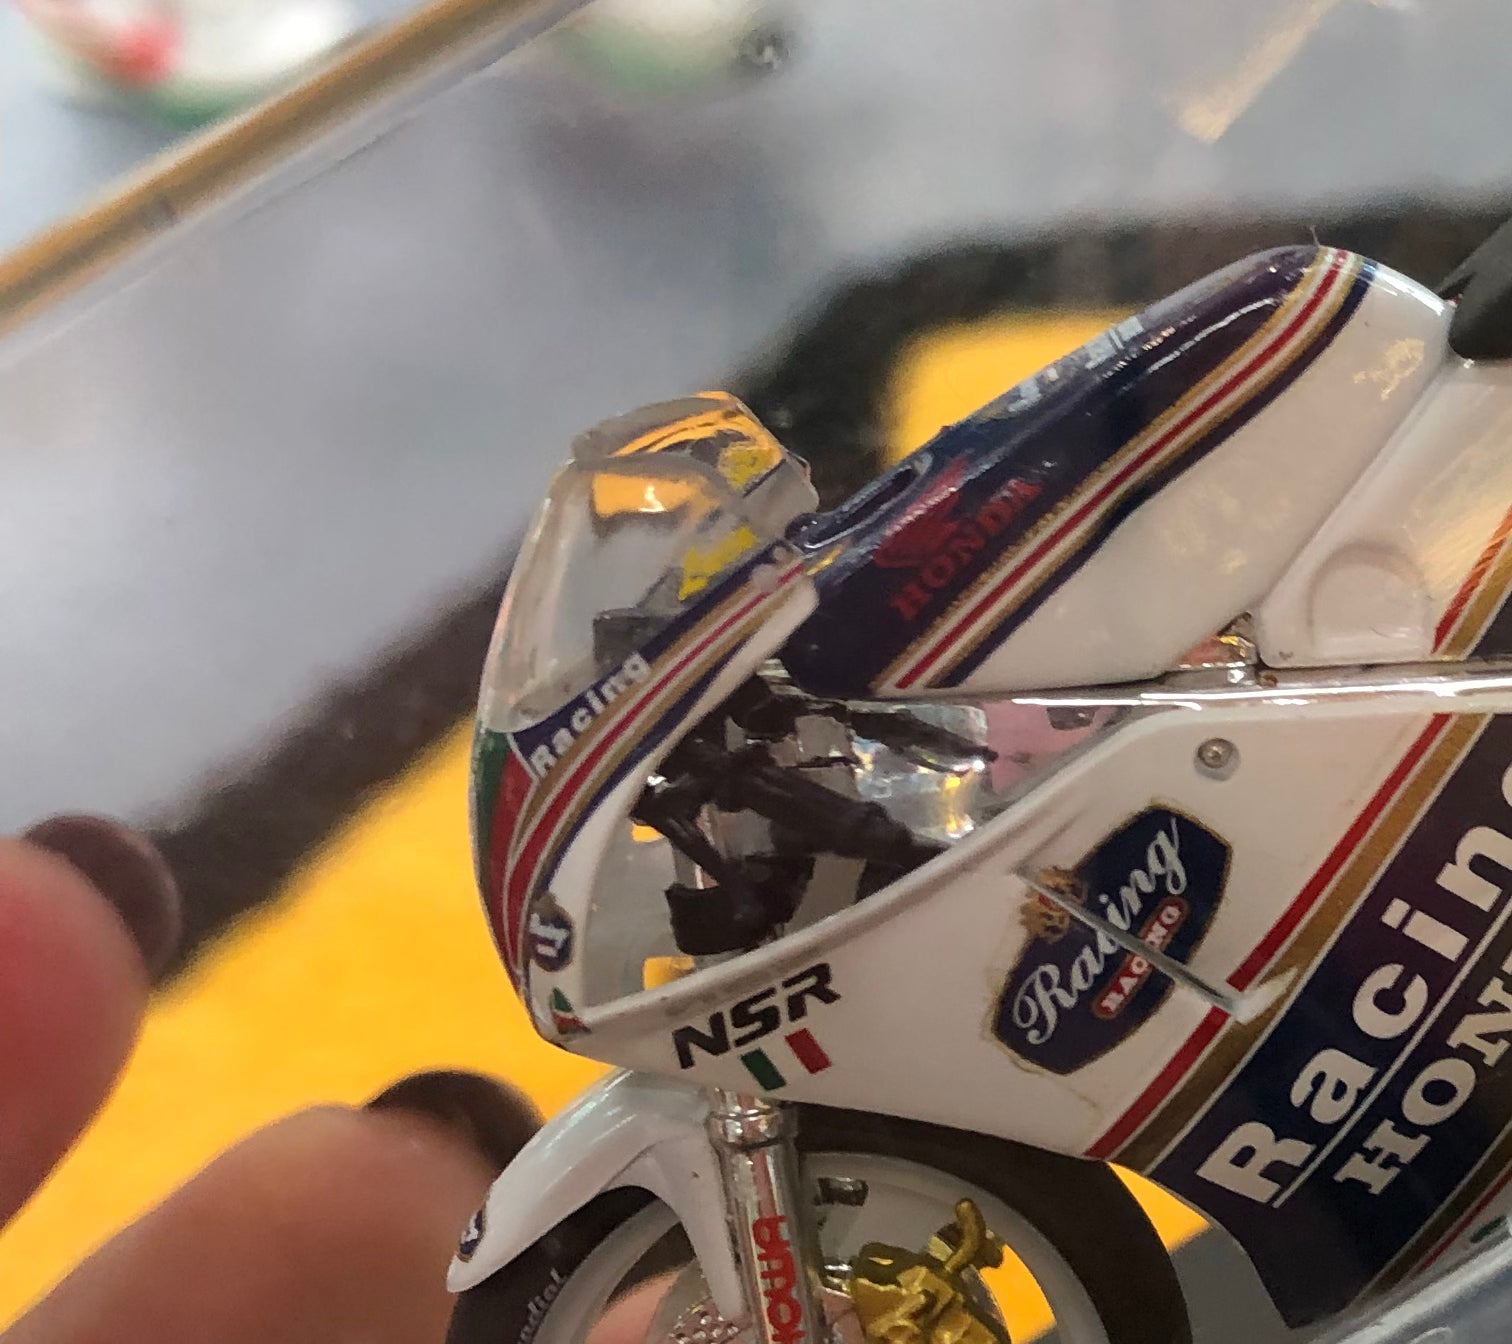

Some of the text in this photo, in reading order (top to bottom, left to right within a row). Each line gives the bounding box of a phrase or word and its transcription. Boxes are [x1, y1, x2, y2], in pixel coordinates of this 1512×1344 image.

[891, 478, 1042, 621] HONDA
[532, 652, 651, 778] Racing
[672, 962, 841, 1070] NSR
